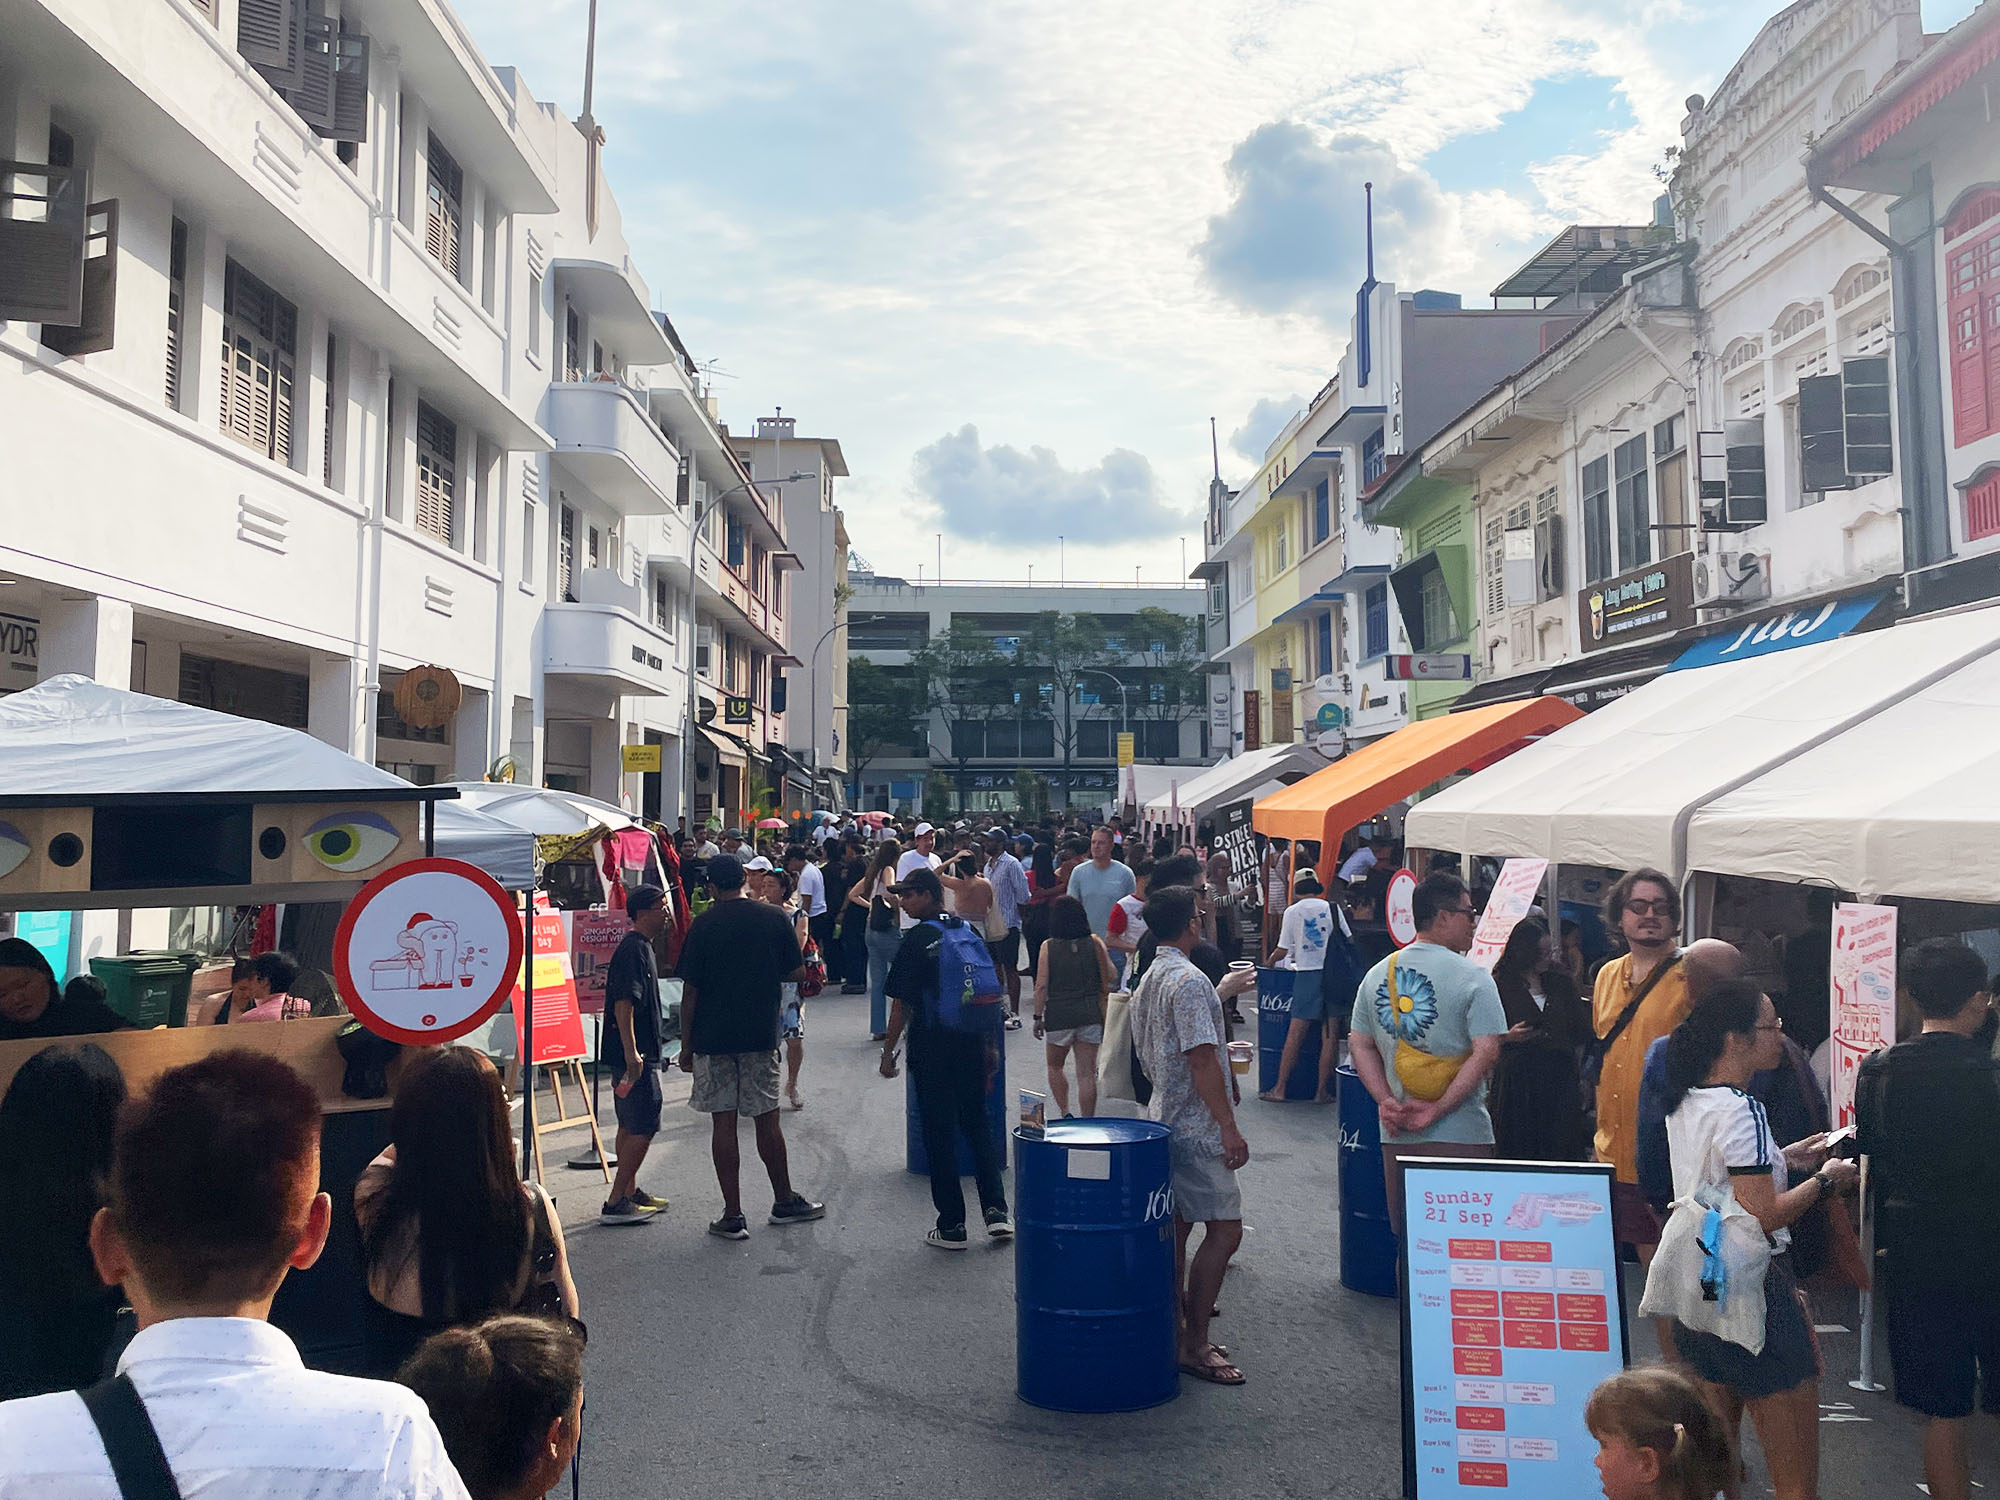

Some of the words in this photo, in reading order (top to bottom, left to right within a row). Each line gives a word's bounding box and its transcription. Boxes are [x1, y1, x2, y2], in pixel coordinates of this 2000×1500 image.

[580, 935, 608, 943] DESIGN
[1424, 1190, 1494, 1207] Sunday
[1425, 1207, 1447, 1222] 21
[1459, 1210, 1493, 1227] Sep
[1424, 1407, 1448, 1417] Urban
[1424, 1415, 1452, 1424] Sports
